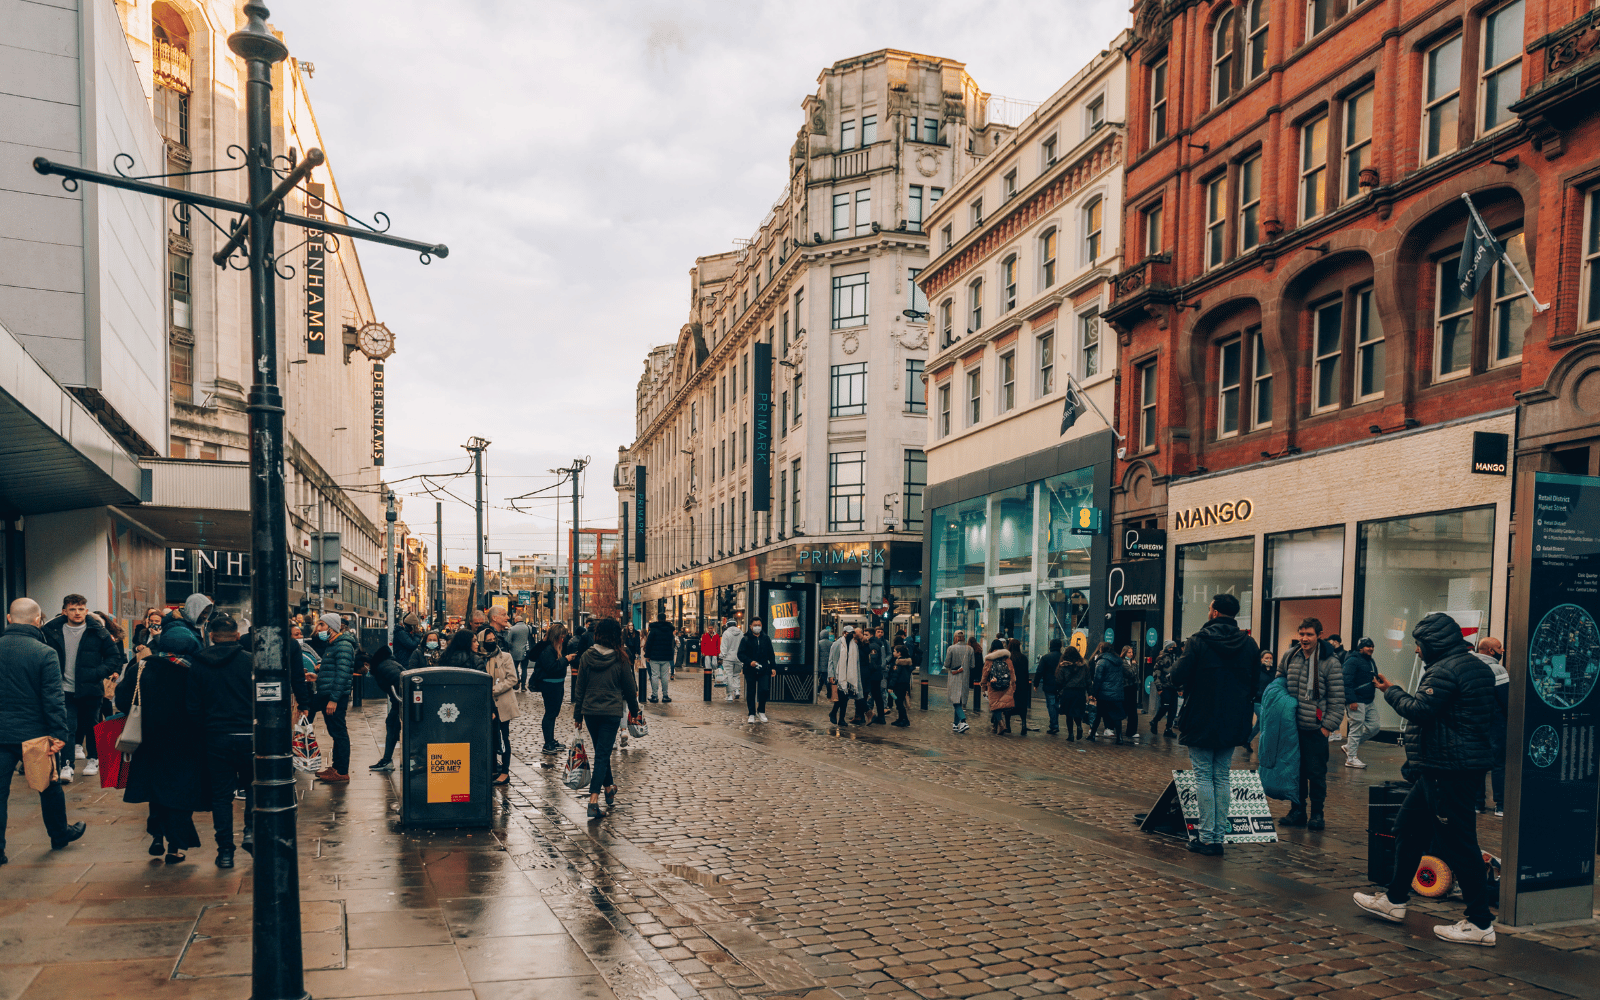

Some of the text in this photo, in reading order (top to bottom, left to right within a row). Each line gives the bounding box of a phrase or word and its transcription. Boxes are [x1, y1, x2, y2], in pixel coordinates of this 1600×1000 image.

[307, 196, 325, 341] DEBENHAMS
[373, 370, 384, 459] DEBENHAMS
[756, 392, 767, 465] PRIMARK
[1475, 463, 1505, 472] MANGO
[1175, 498, 1253, 531] MANGO
[799, 548, 886, 564] PRIMARK
[1123, 593, 1157, 606] PUREGYM
[776, 602, 794, 618] BIN
[1181, 787, 1265, 806] Ga Man
